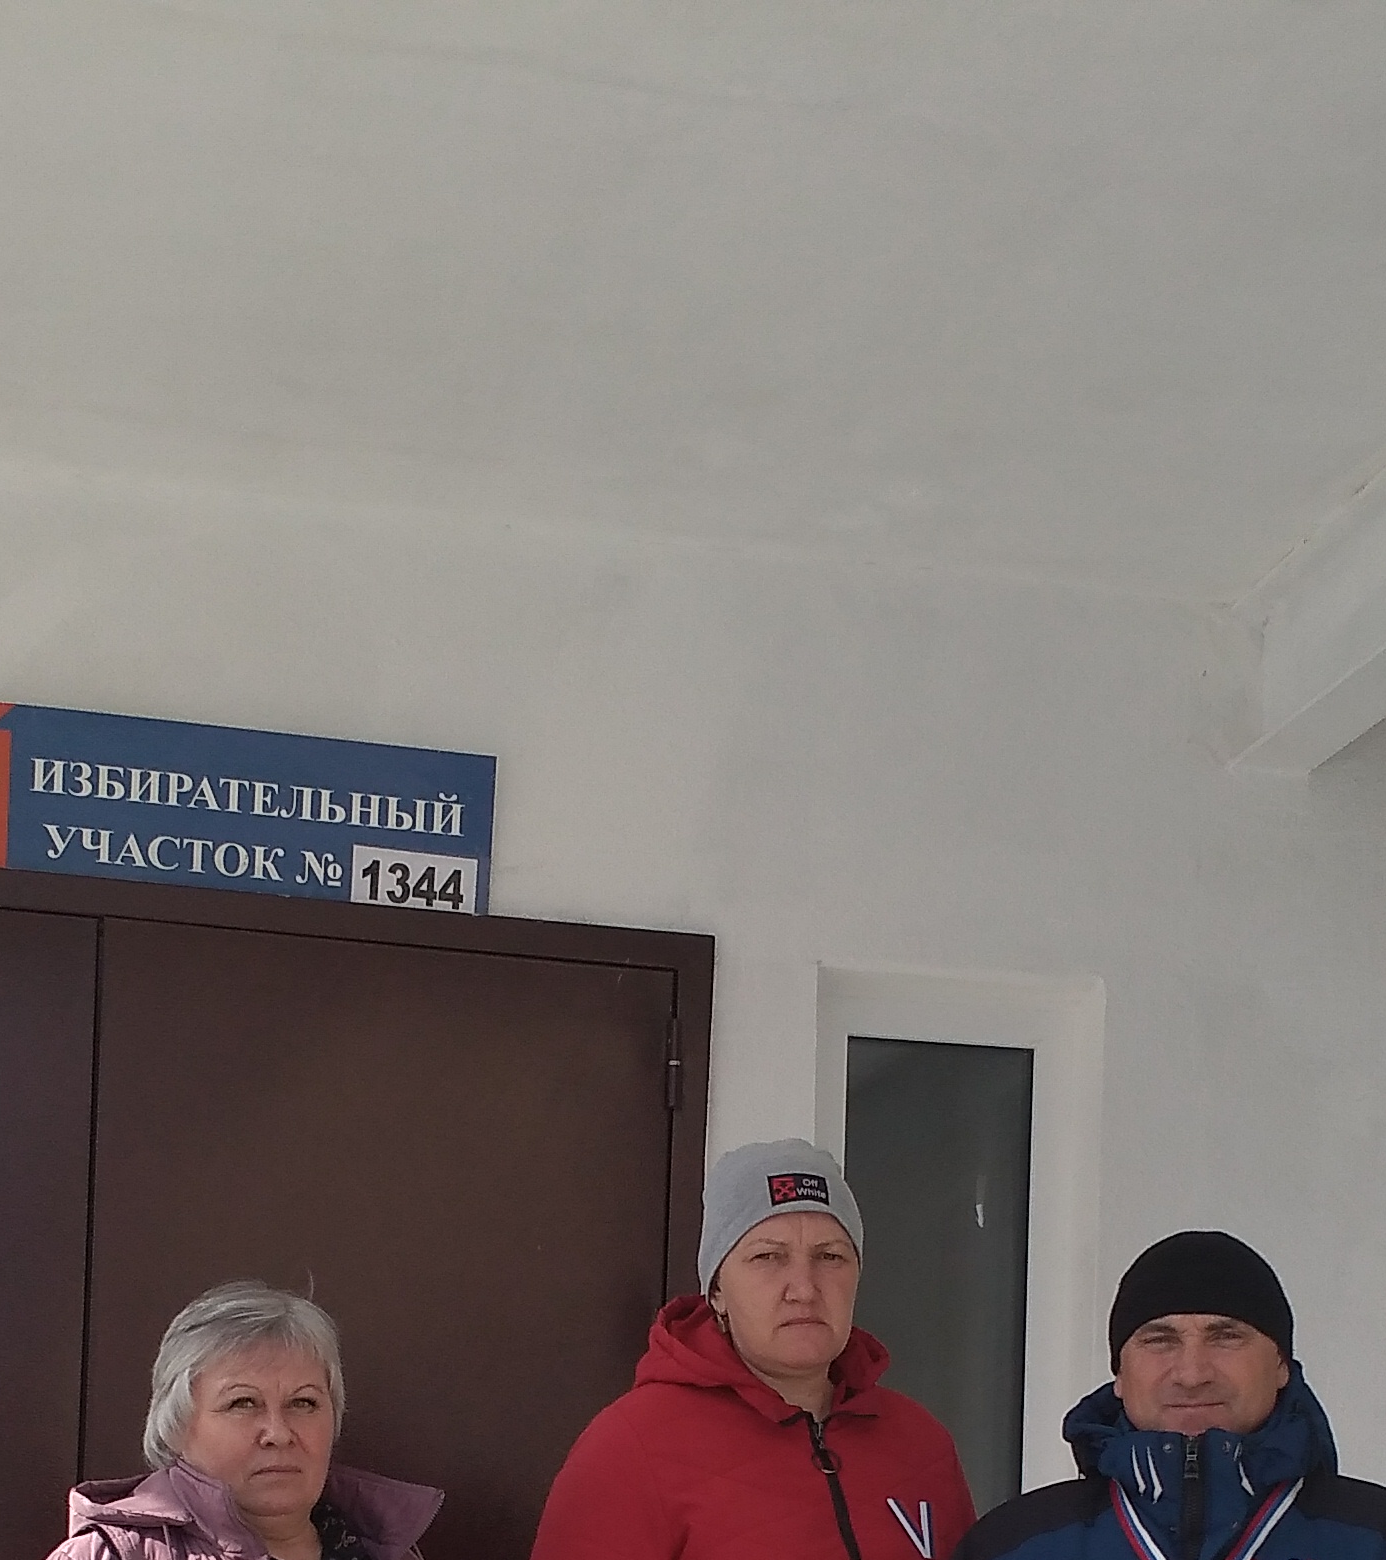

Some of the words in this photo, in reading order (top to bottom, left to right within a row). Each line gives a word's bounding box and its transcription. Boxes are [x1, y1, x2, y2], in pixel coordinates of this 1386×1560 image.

[29, 757, 466, 838] ИЗБИРАТЕЛЬНЫЙ
[44, 824, 285, 882] УЧАСТОК
[295, 851, 344, 888] №
[360, 858, 464, 910] 1344
[797, 1188, 826, 1198] White
[802, 1178, 819, 1187] Off
